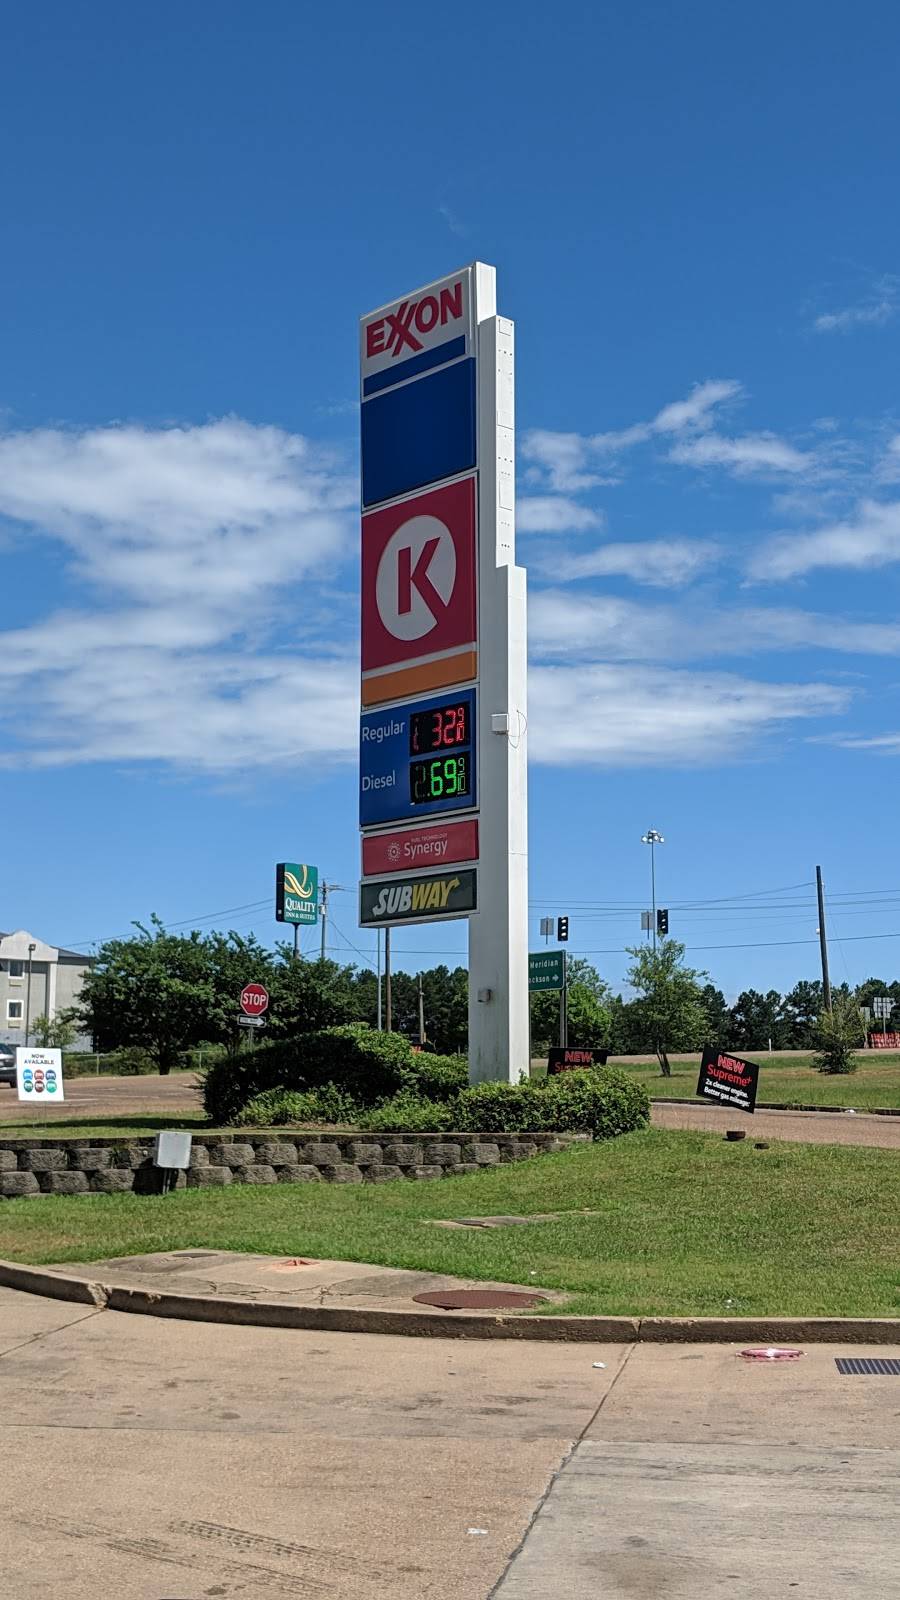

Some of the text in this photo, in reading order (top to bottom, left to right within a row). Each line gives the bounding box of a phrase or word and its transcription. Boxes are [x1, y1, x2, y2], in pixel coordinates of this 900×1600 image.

[366, 282, 463, 358] EXXON
[398, 537, 446, 623] K
[362, 720, 405, 743] Regular
[362, 770, 396, 791] Diesel
[404, 840, 448, 860] Synergy
[285, 897, 317, 913] QUALITY
[372, 877, 461, 917] SUBWAY
[530, 959, 559, 969] Meridian
[243, 993, 267, 1006] STOP
[564, 1050, 593, 1063] NEW
[717, 1054, 745, 1074] NEW
[704, 1086, 721, 1097] Better
